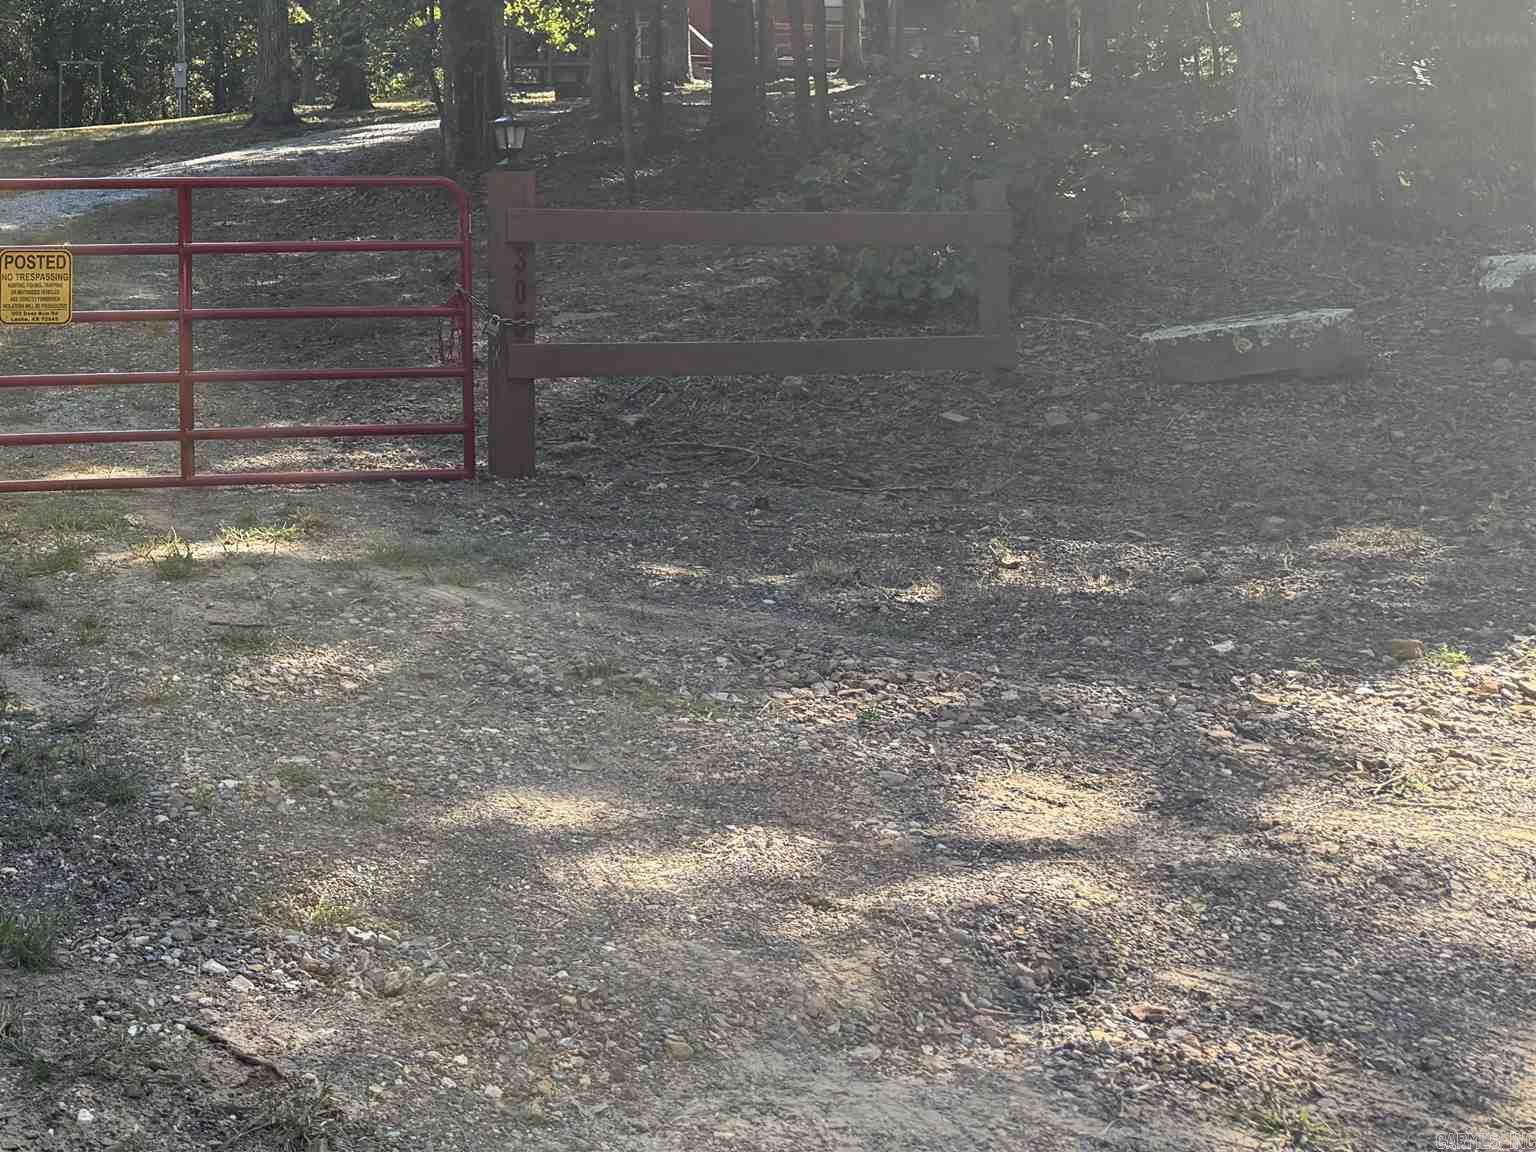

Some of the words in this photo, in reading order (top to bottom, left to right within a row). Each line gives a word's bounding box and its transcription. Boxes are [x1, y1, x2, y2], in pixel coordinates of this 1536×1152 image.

[4, 254, 67, 270] POSTED
[1, 272, 13, 281] NO
[16, 272, 70, 281] TRESPASSING
